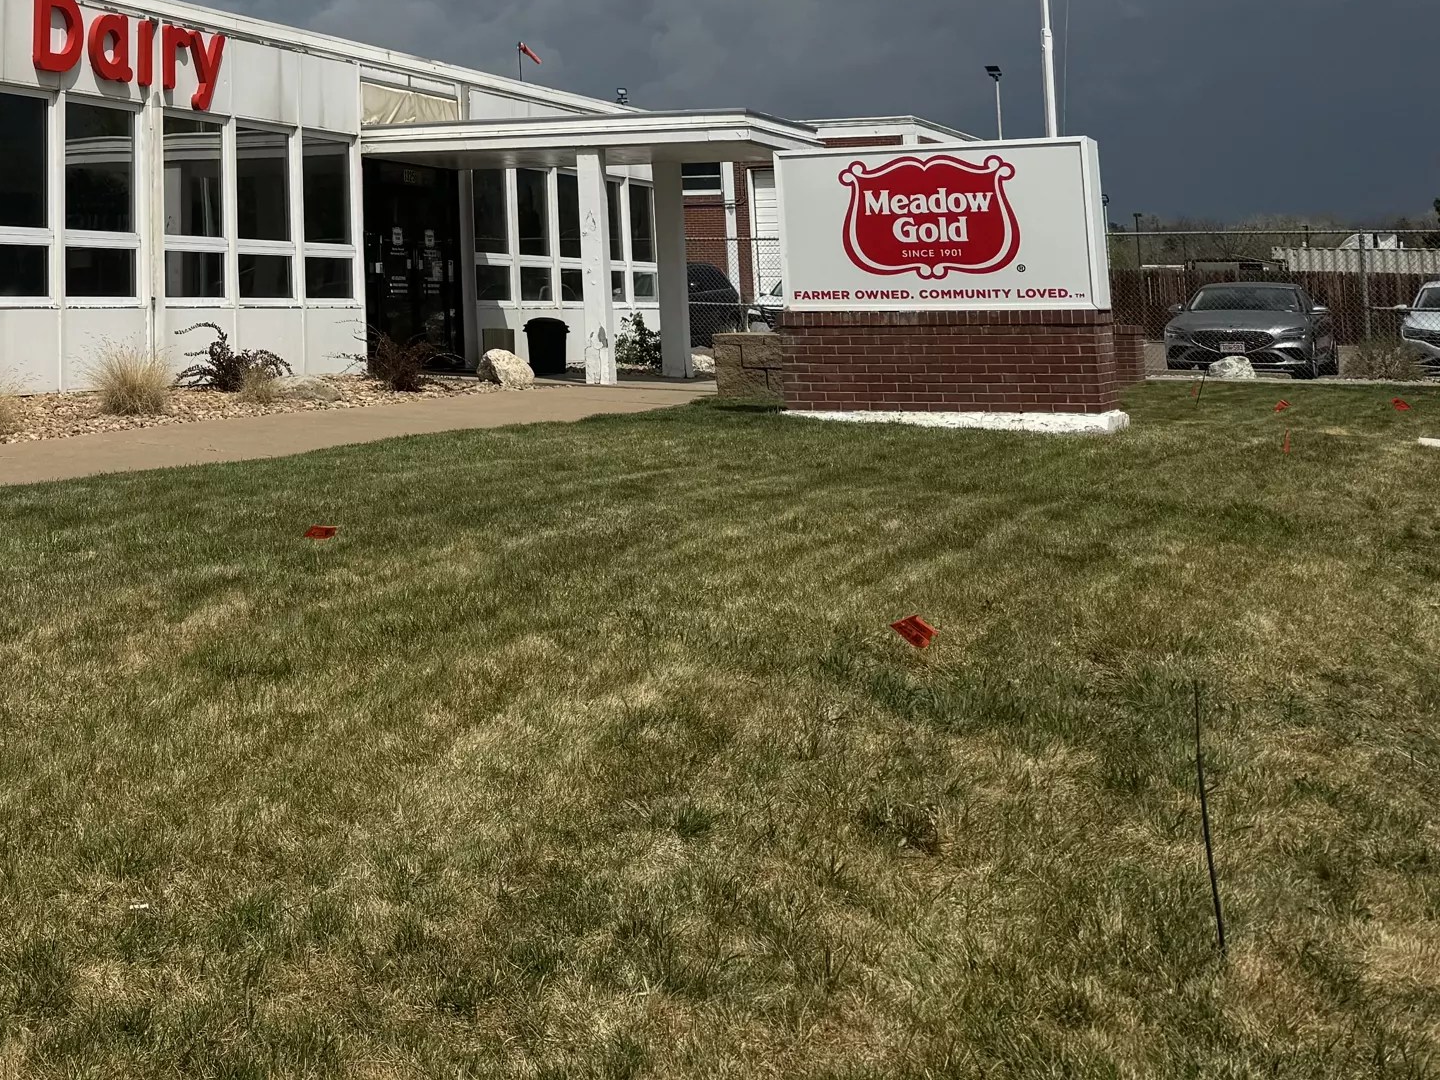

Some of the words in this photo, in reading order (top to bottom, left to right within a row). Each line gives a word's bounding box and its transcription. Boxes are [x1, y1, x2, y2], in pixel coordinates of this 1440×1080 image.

[863, 188, 994, 216] Meadow
[892, 216, 969, 243] Gold
[901, 249, 935, 258] SINCE
[940, 248, 962, 257] 1901
[794, 290, 850, 300] FARMER
[855, 290, 914, 300] OWNED.
[919, 289, 1011, 299] COMMUNITY
[1017, 288, 1073, 299] LOVED.
